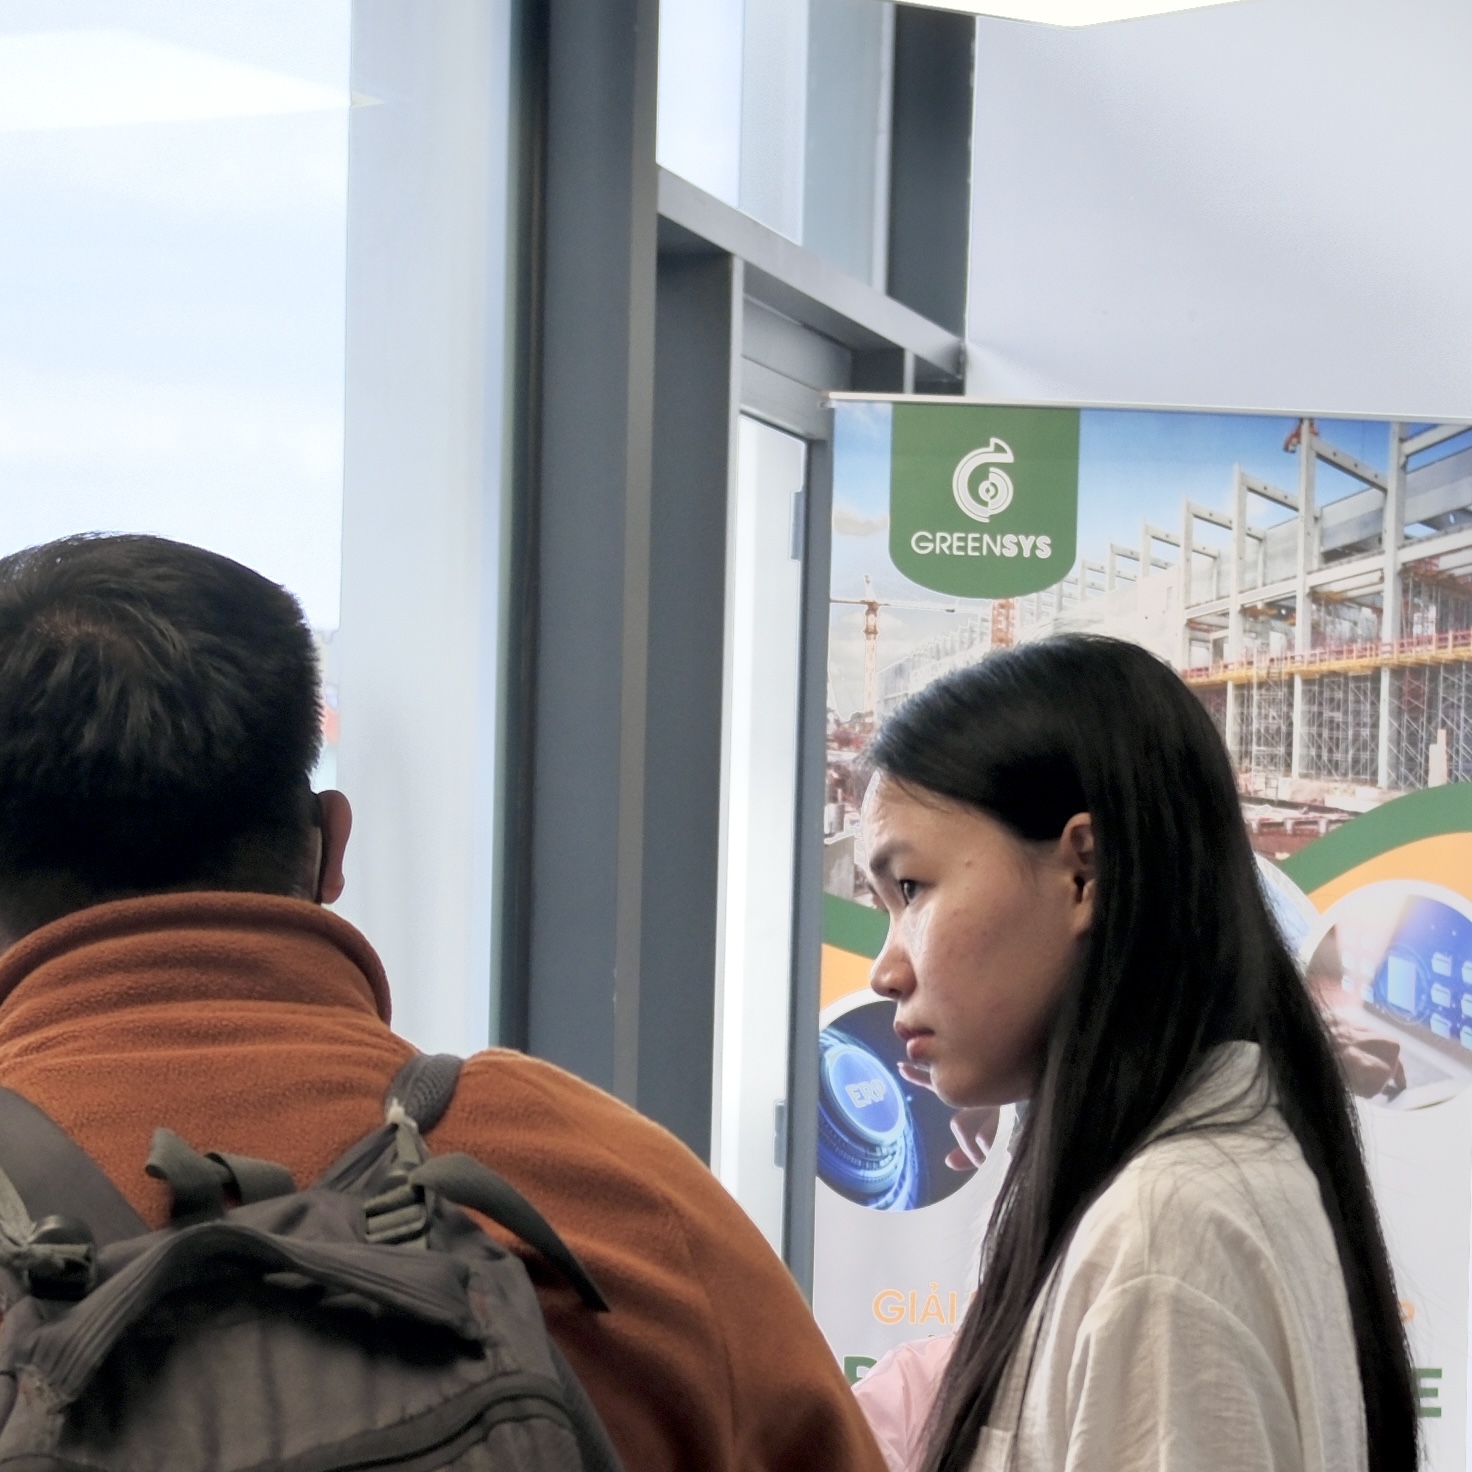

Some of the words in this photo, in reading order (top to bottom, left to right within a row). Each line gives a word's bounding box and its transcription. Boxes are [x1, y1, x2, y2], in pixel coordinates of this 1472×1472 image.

[911, 531, 1052, 559] GREENSYS
[845, 1079, 887, 1108] ERP
[872, 1282, 957, 1325] GIẢI
